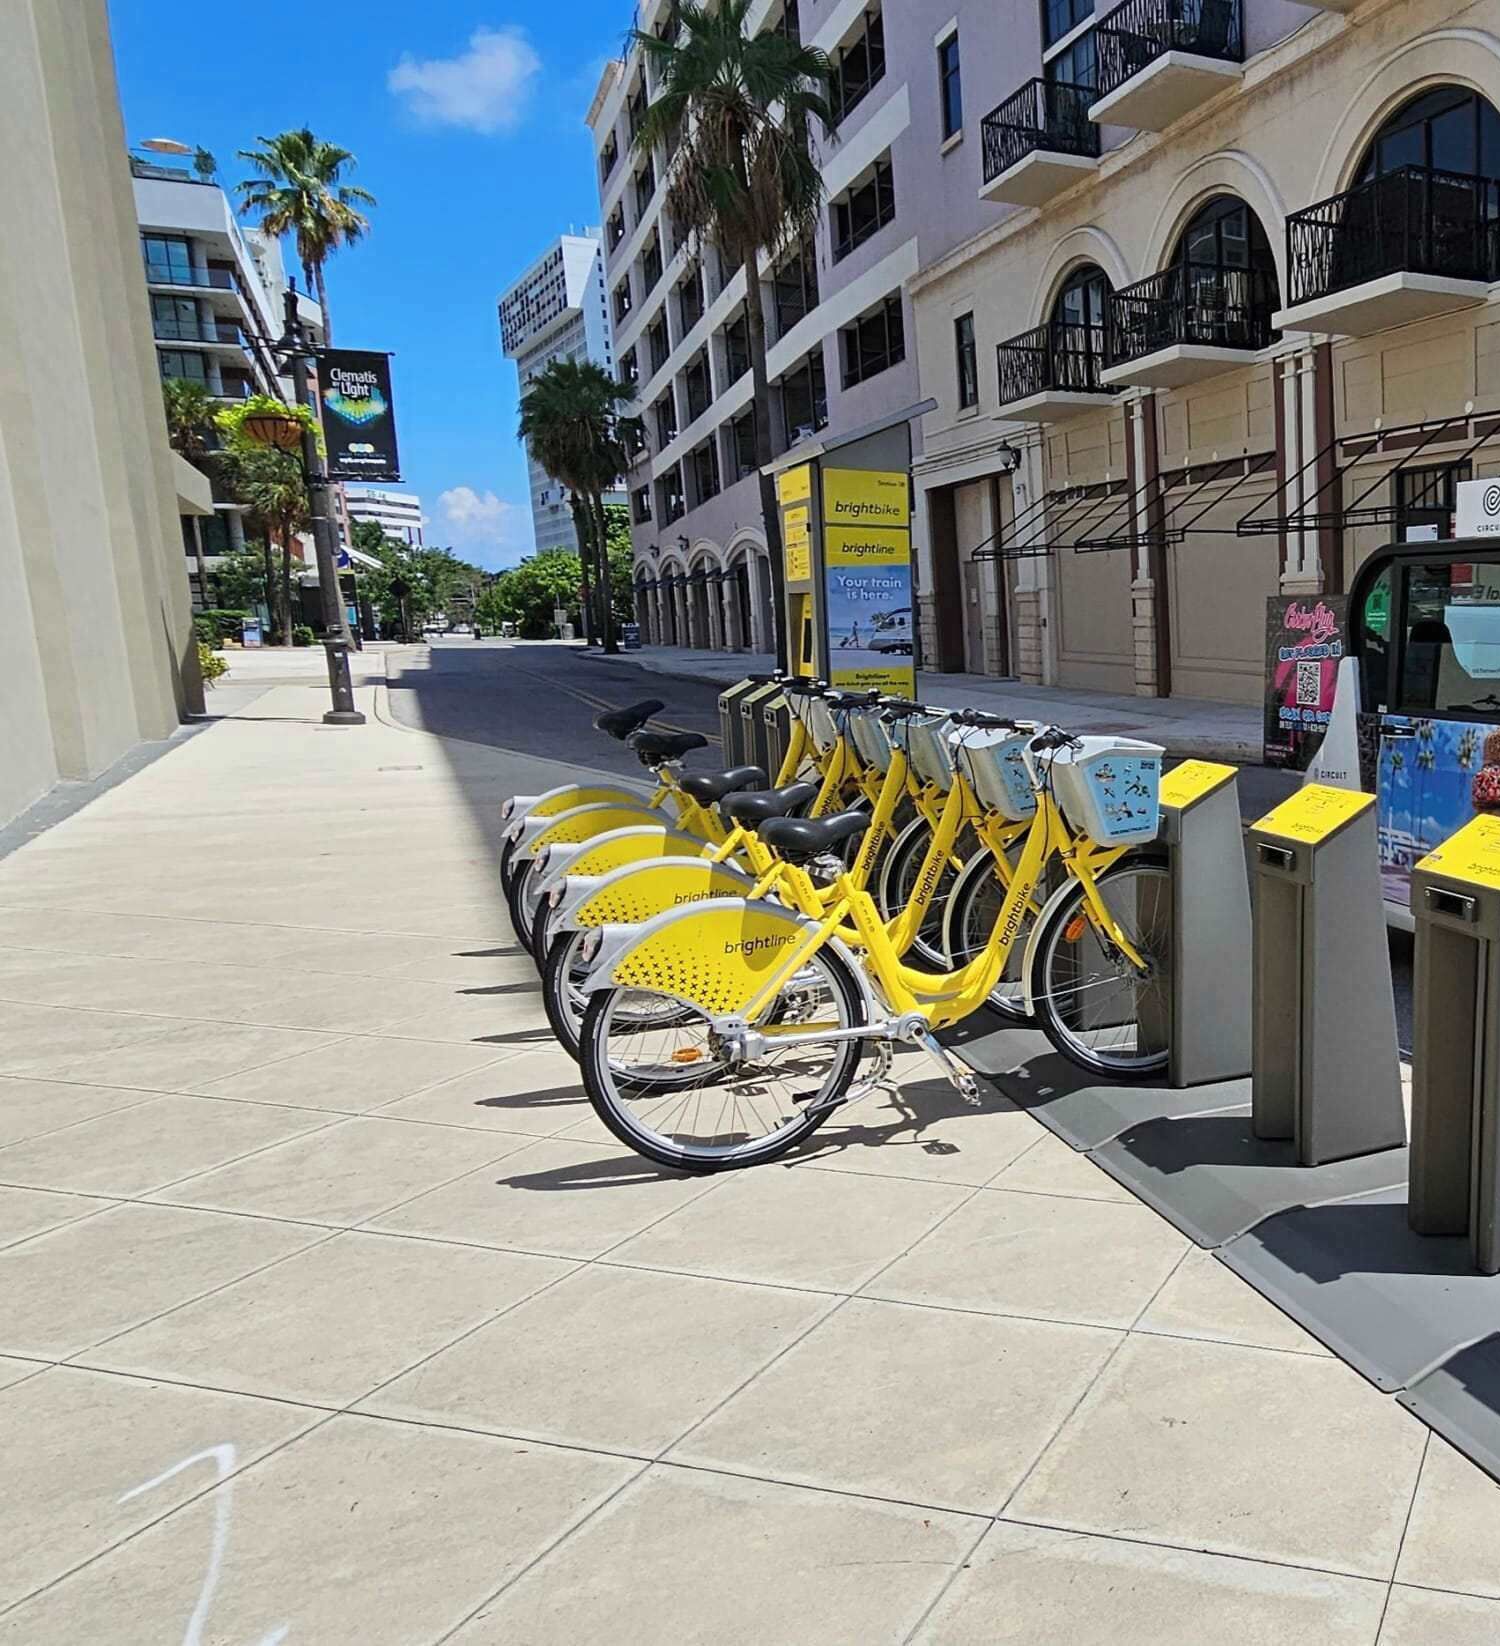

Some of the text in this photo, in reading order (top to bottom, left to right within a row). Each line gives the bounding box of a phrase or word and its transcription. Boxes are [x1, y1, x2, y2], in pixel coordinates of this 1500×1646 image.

[330, 367, 377, 383] Clematis
[341, 382, 370, 398] Light
[835, 501, 900, 517] brightbike
[842, 543, 895, 557] brightline
[837, 576, 902, 588] Your train
[847, 589, 893, 600] is here.
[1321, 771, 1347, 779] CIRCUIT
[862, 821, 886, 871] brightbike
[914, 849, 944, 906] brightbike
[998, 882, 1031, 946] brightbike
[724, 934, 796, 955] brightline
